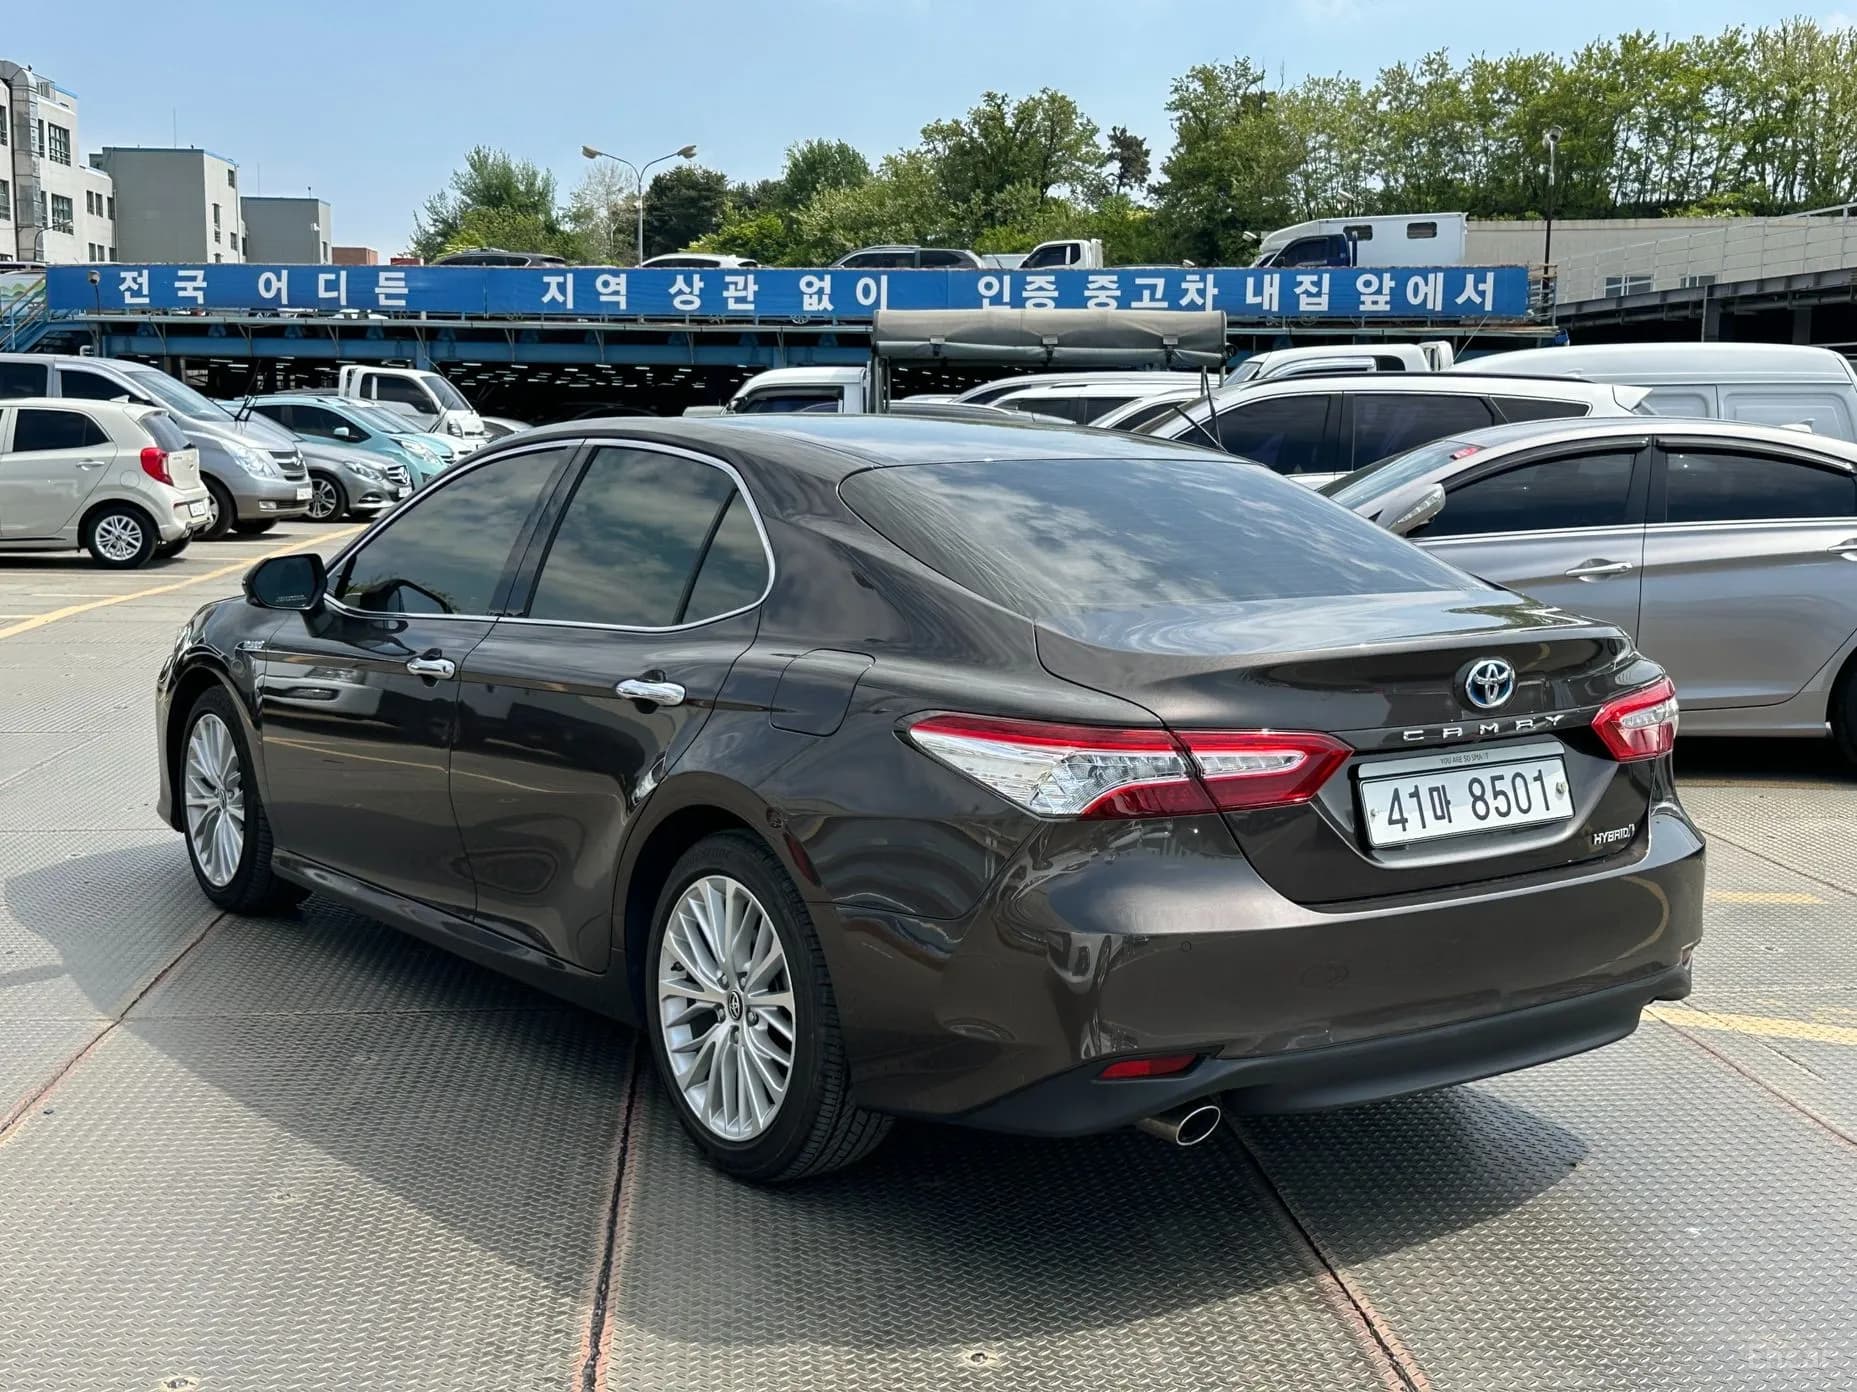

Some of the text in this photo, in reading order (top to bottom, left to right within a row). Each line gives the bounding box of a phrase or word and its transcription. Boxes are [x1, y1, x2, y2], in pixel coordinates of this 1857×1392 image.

[118, 269, 1495, 312] 전국 어디든 지역 상관 없이 인증 중고차 내집 앞에서
[1403, 714, 1565, 742] CAMRY
[1387, 768, 1552, 832] 41마 8501
[1593, 826, 1630, 845] HYBRID
